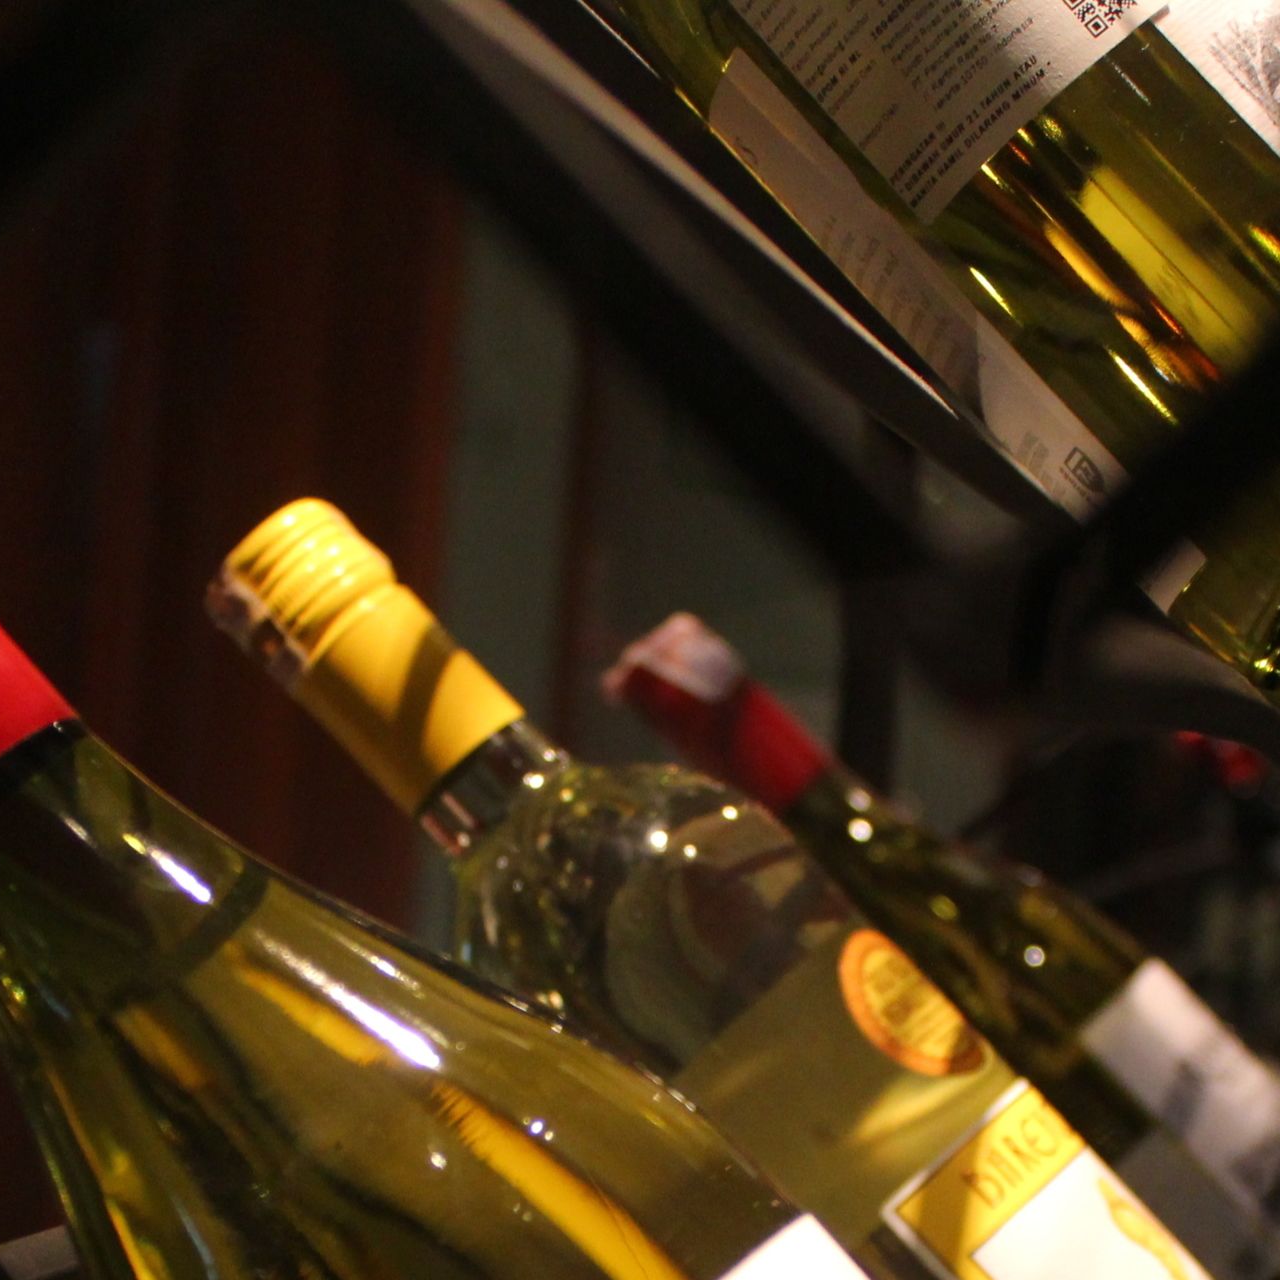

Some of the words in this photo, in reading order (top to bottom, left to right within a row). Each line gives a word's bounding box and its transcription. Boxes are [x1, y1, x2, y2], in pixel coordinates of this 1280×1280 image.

[979, 78, 1011, 108] TAHUN
[1012, 54, 1037, 79] ATAU
[936, 148, 962, 175] HAMIL
[963, 100, 1011, 147] DILARANG
